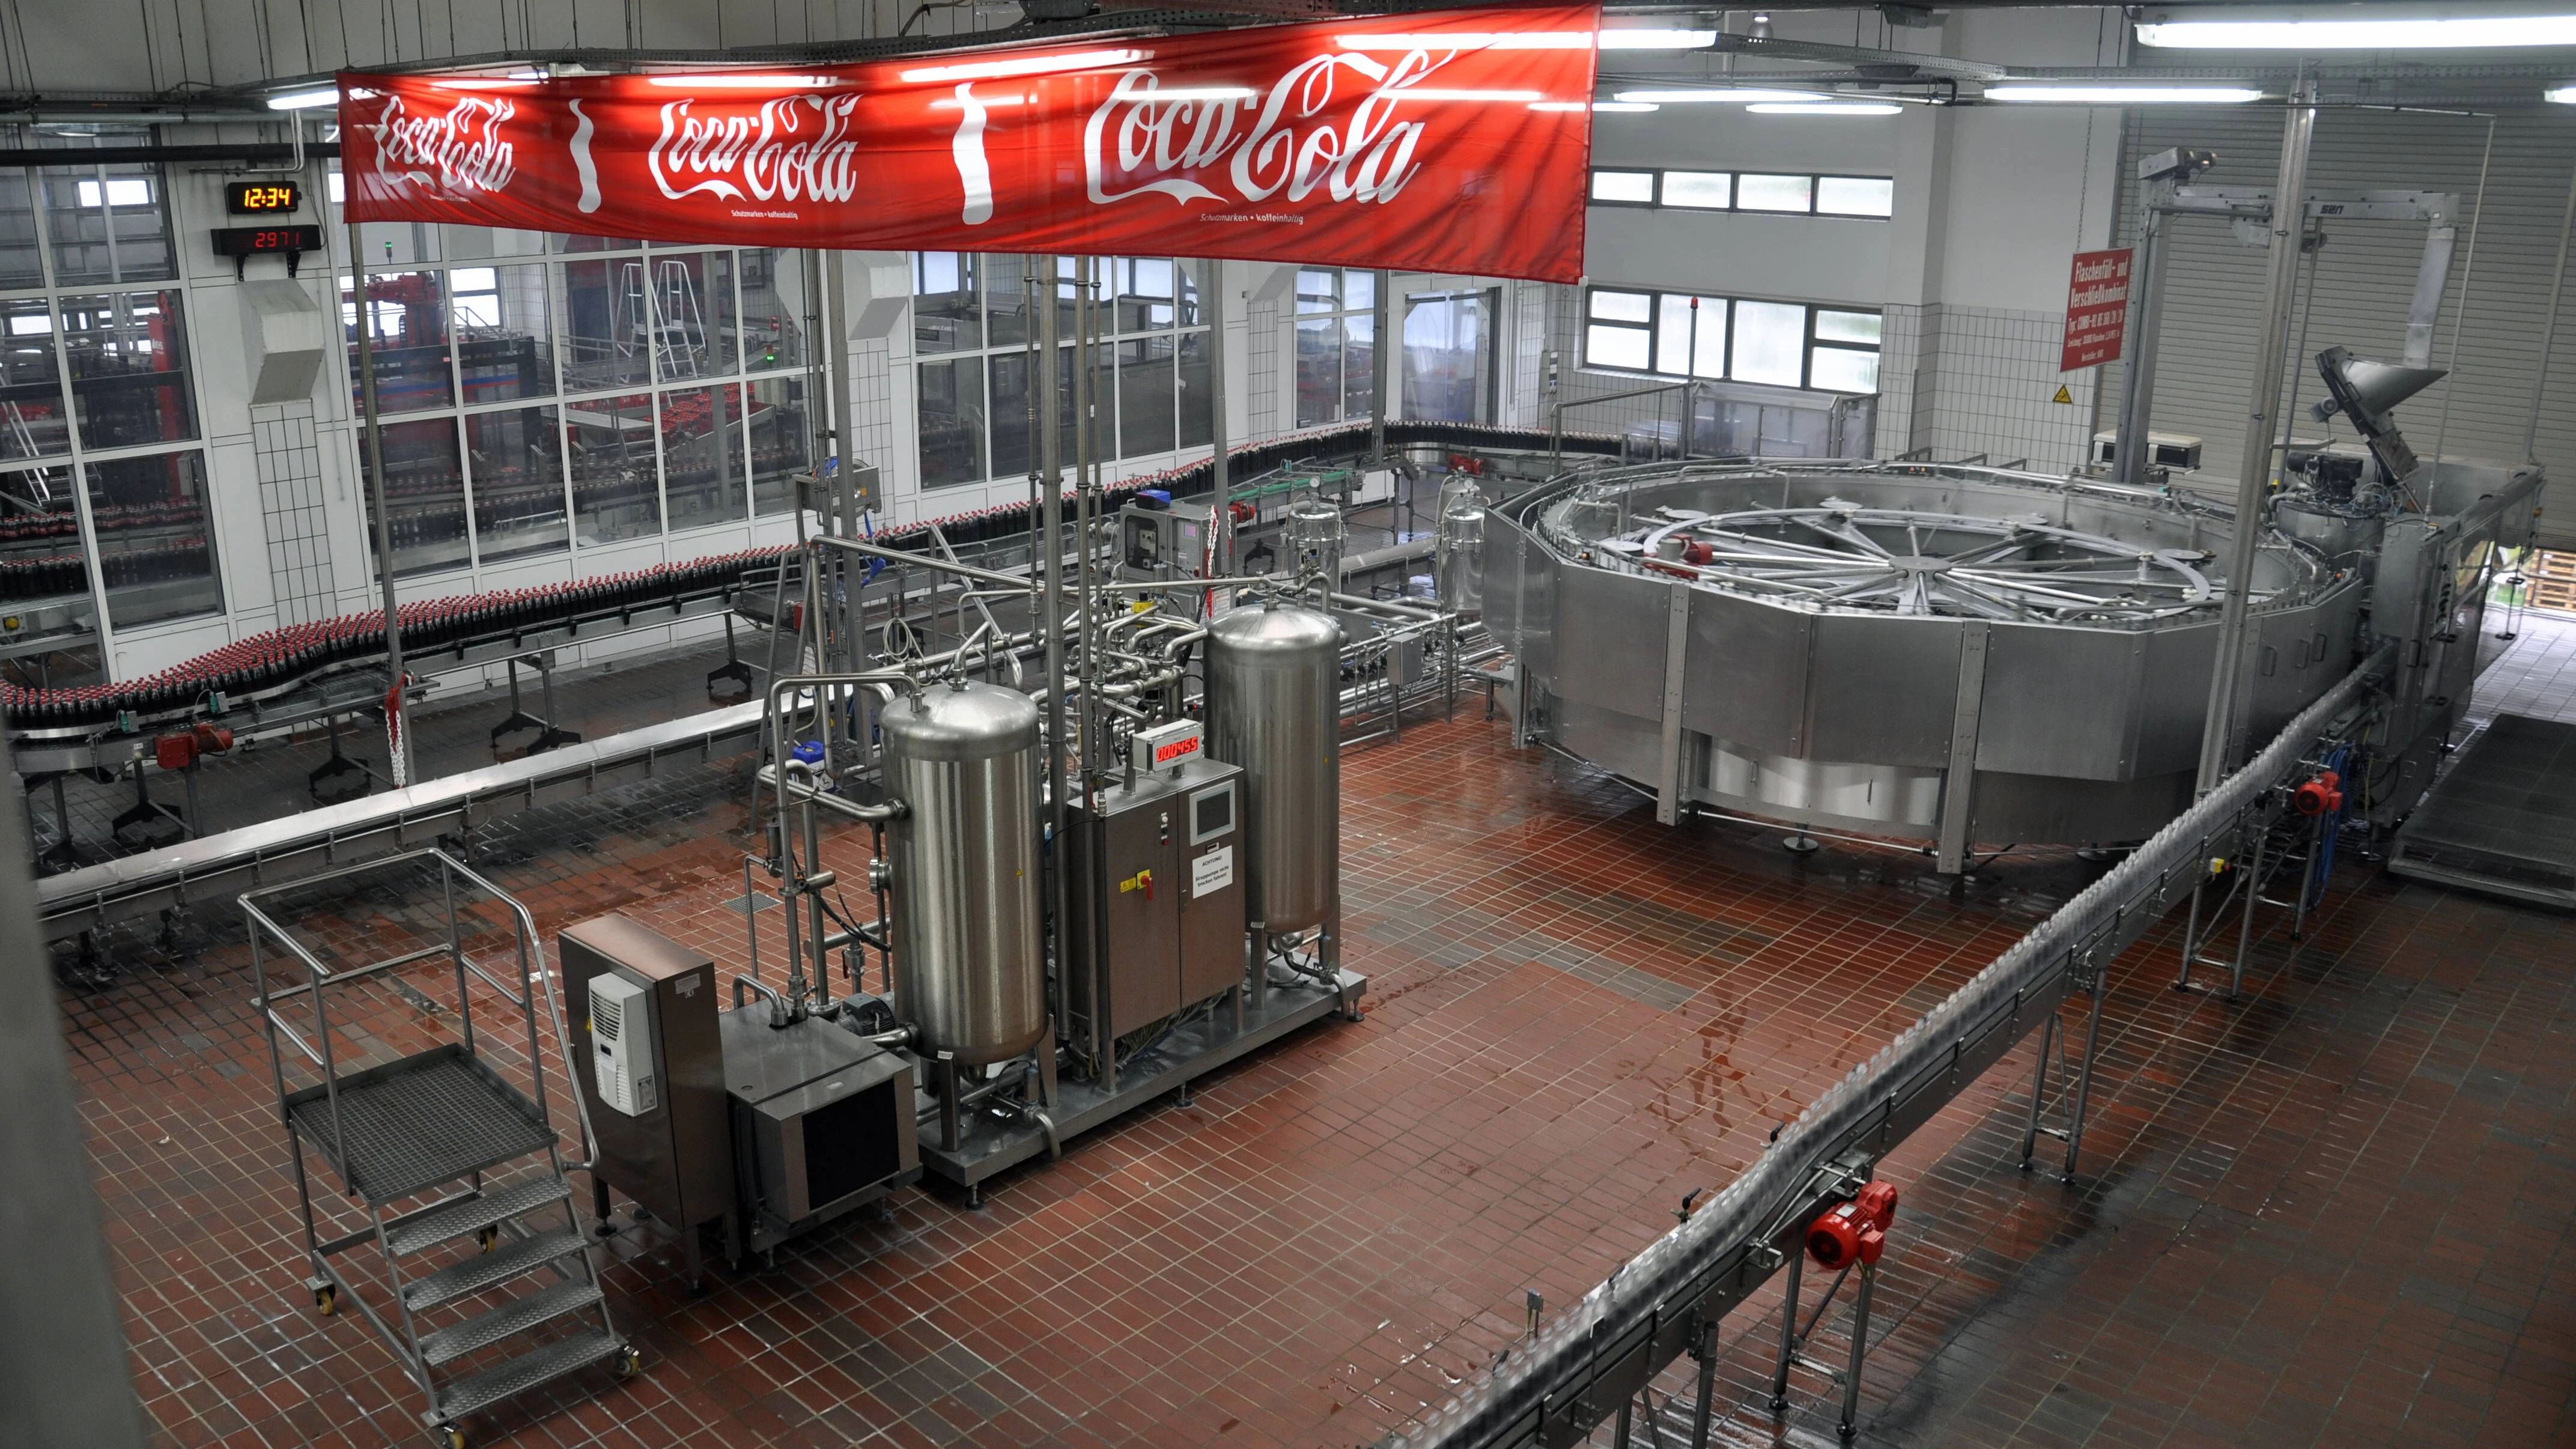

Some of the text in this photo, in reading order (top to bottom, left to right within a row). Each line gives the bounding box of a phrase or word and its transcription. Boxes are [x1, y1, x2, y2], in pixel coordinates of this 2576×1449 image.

[1084, 49, 1458, 206] Coca-Cola
[374, 95, 516, 193] Coca-Cola
[648, 93, 866, 202] Coca-Cola
[245, 188, 290, 207] 12:34
[768, 210, 798, 220] koffeinhaltig
[1200, 213, 1304, 225] Schutzmarken koffeinhaltig
[255, 231, 300, 248] 2971
[2075, 257, 2128, 283] Flaschenfüll- und
[1157, 735, 1198, 762] 000455
